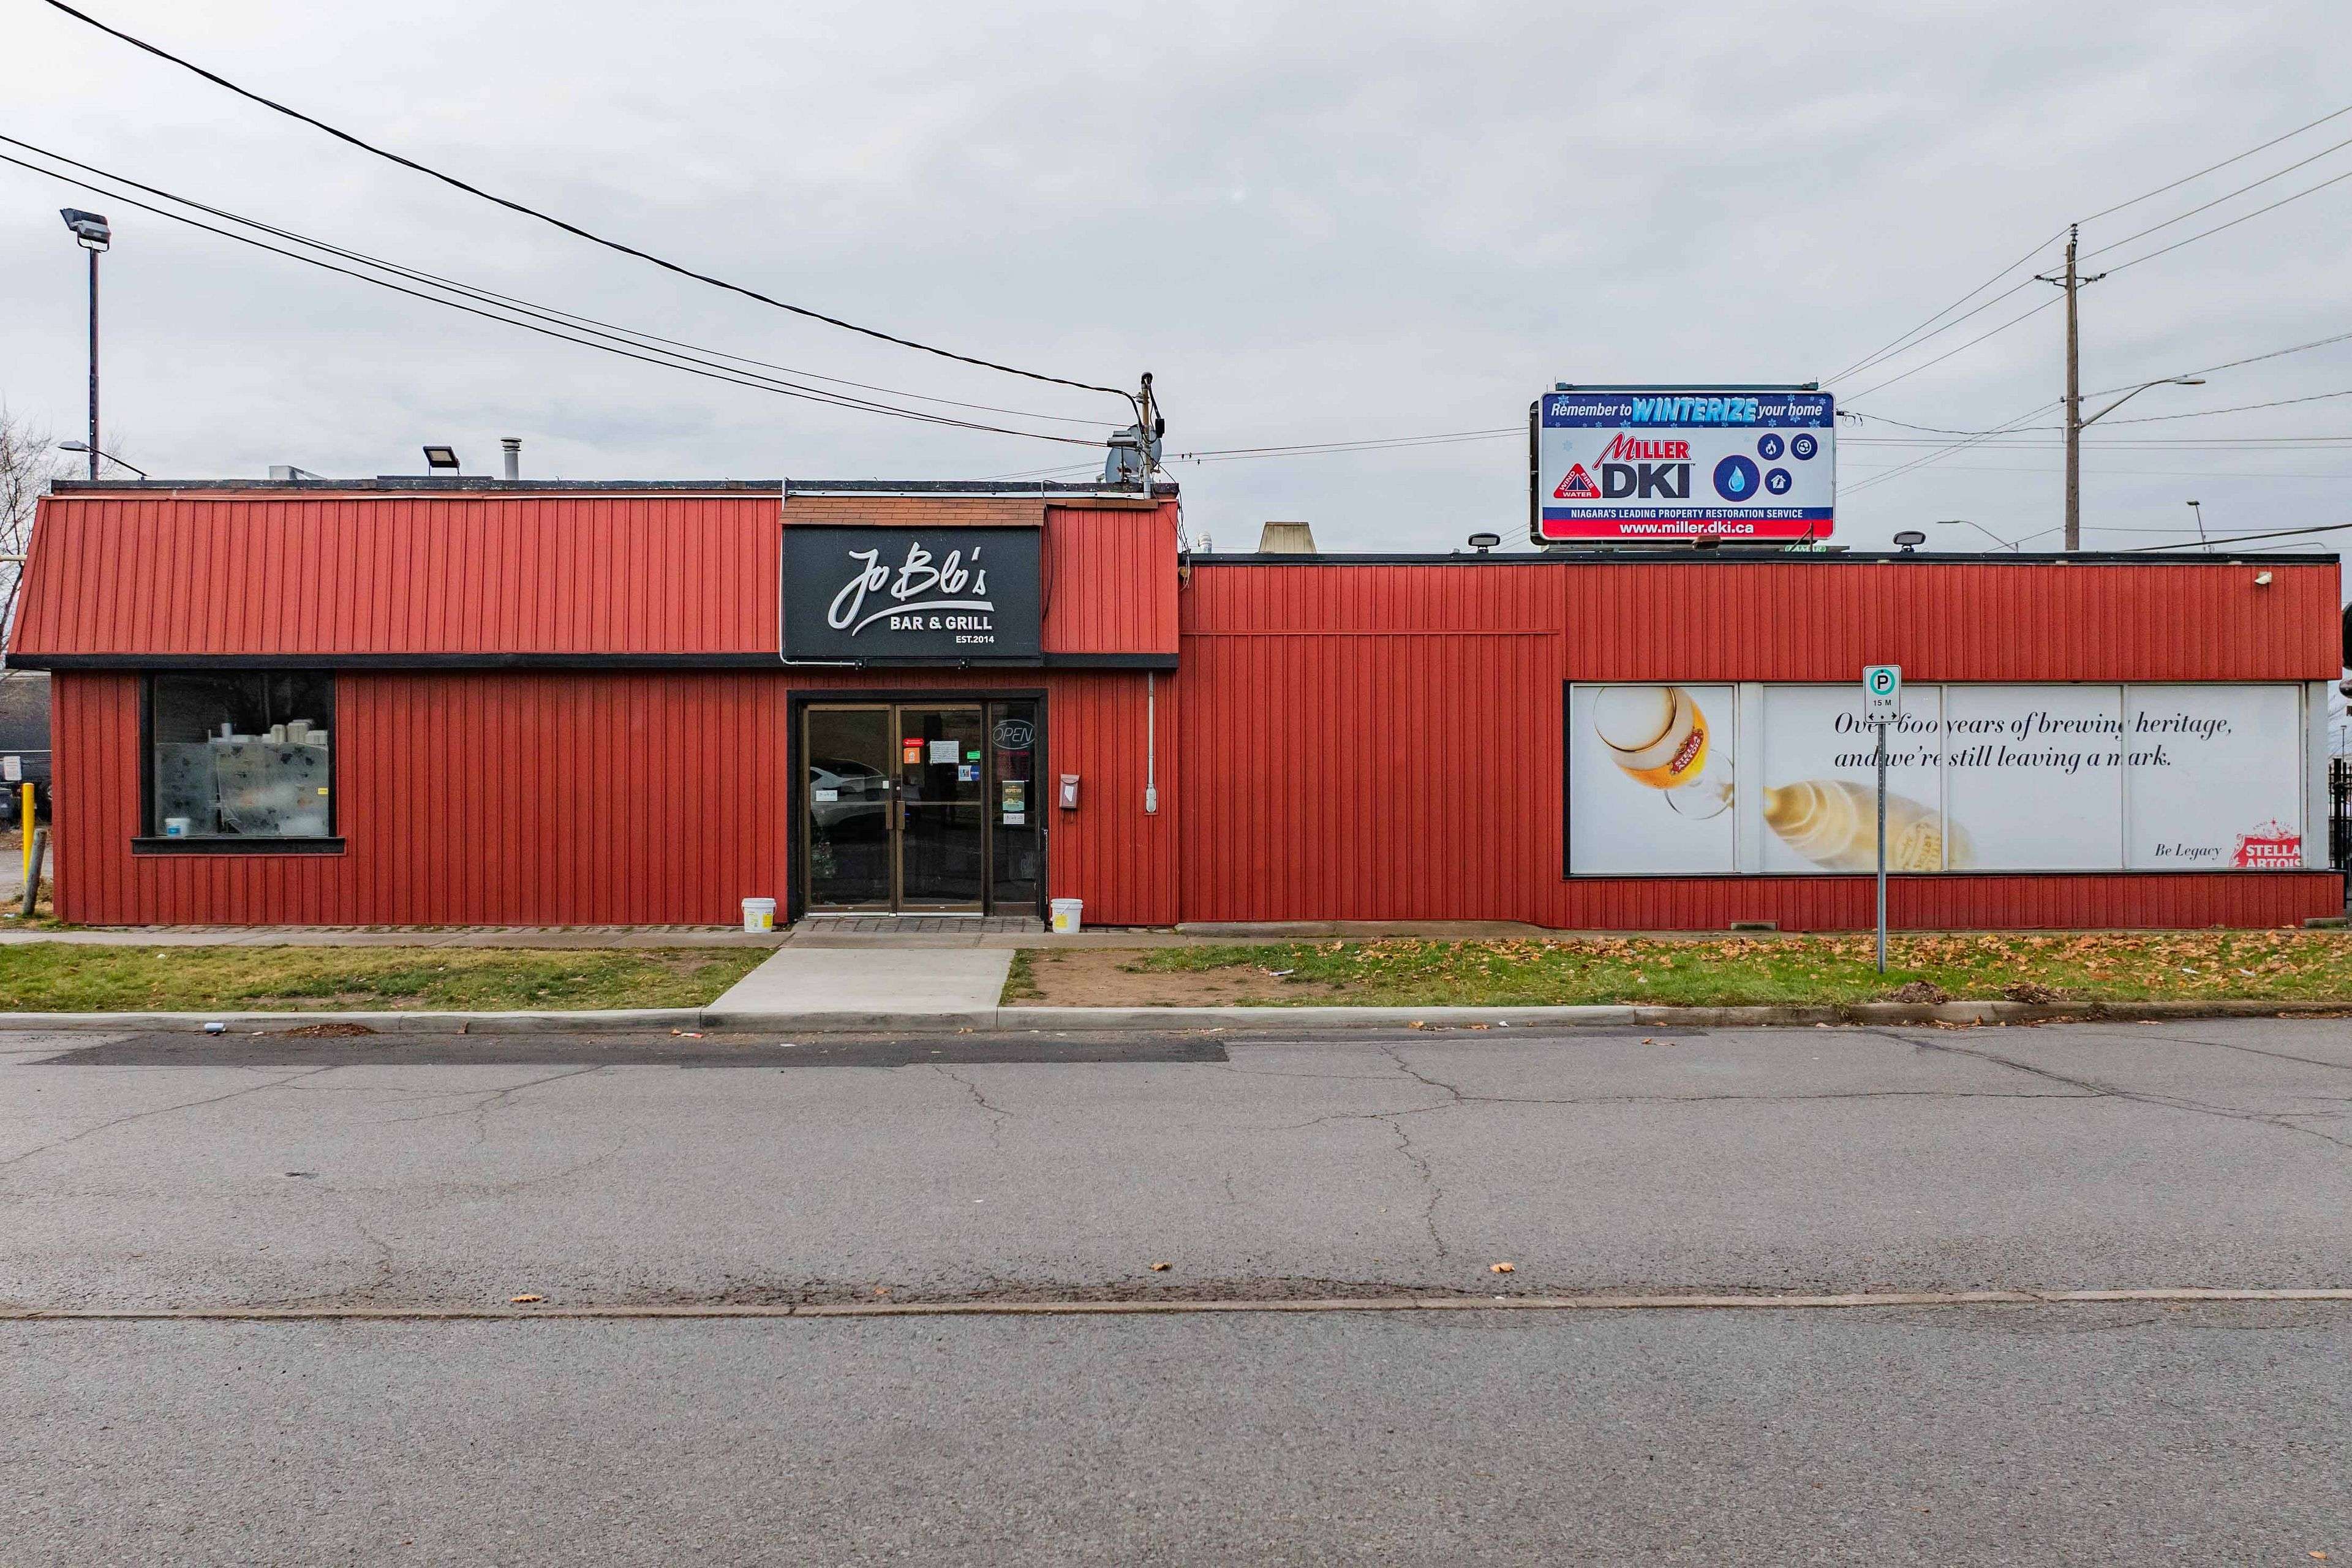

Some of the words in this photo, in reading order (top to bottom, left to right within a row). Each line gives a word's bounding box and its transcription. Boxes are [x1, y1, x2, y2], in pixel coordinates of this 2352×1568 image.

[1551, 402, 1618, 416] Remember
[1620, 404, 1632, 416] to
[1632, 397, 1758, 423] WINTERIZE
[1757, 405, 1786, 419] your
[1788, 402, 1822, 416] home
[1559, 471, 1575, 490] WIND
[1581, 472, 1594, 488] FIRE
[1602, 464, 1689, 498] DKI
[1571, 510, 1616, 518] NIAGARA'S
[1619, 510, 1656, 518] LEADING
[1659, 510, 1703, 518] PROPERTY
[1706, 510, 1764, 518] RESTORATION
[1767, 510, 1803, 518] SERVICE
[1619, 521, 1754, 533] www.miller.dki.ca
[891, 616, 924, 630] BAR
[929, 617, 942, 630] &
[945, 616, 992, 630] GRILL
[1877, 676, 1888, 689] P
[1835, 712, 1891, 733] Ove
[1897, 712, 1938, 733] 600
[1947, 720, 2005, 740] years
[2011, 711, 2038, 741] of
[2135, 711, 2231, 741] heritage,
[993, 728, 1033, 741] OPEN
[1885, 745, 1941, 766] we're
[1948, 745, 1992, 766] still
[1997, 745, 2081, 775] leaving
[2087, 753, 2100, 766] a
[2155, 843, 2171, 856] Be
[2175, 843, 2222, 861] Legacy
[2246, 845, 2301, 856] STELLA
